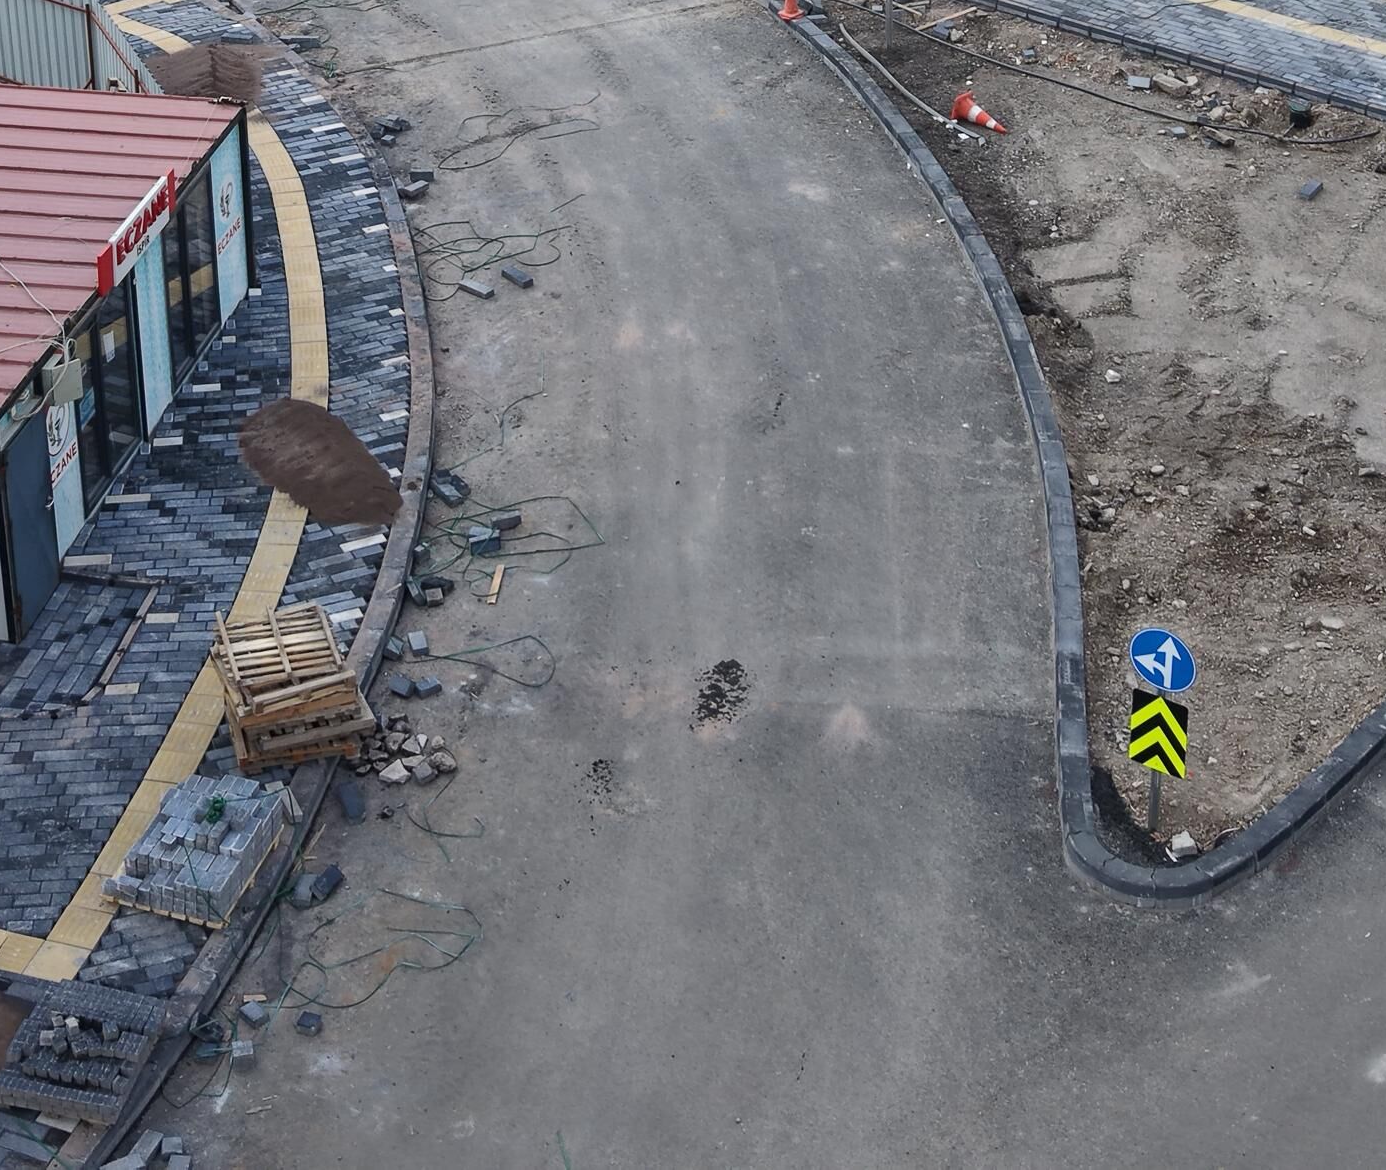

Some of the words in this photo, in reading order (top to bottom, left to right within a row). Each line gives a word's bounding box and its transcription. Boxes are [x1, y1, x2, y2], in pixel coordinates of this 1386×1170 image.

[116, 185, 169, 266] ECZANE
[217, 217, 241, 255] ECZANE
[51, 441, 78, 484] CZANE
